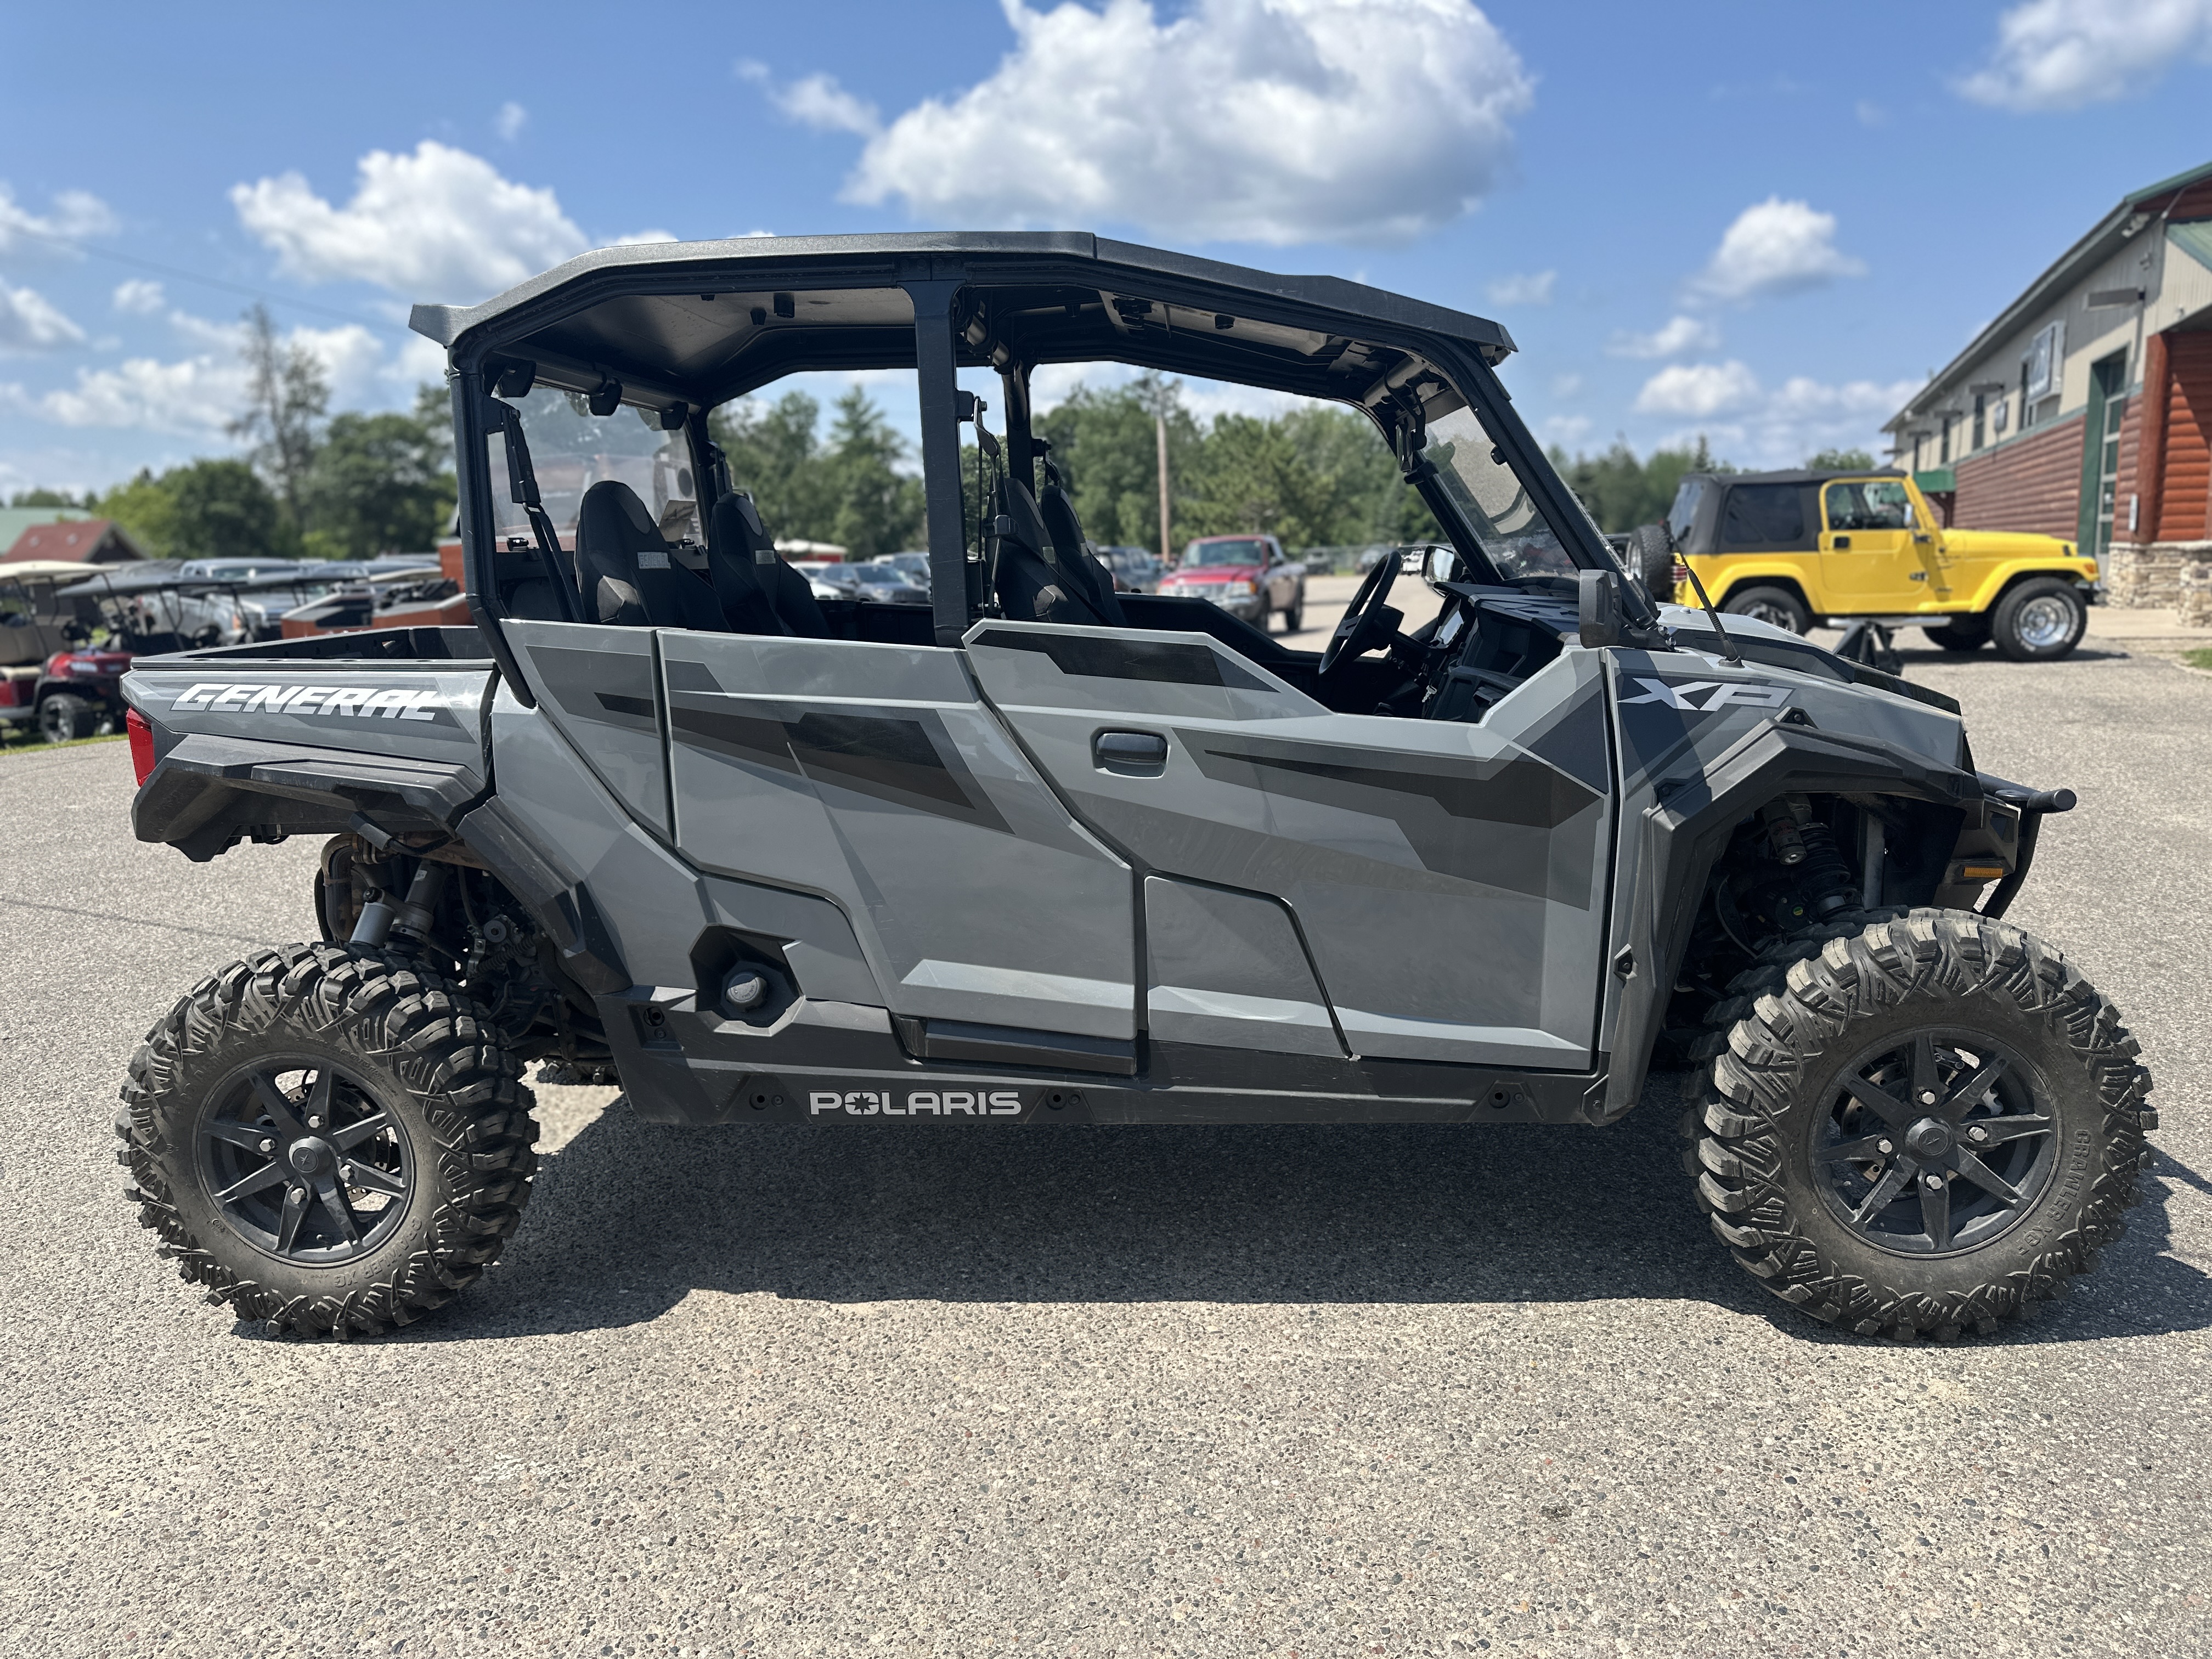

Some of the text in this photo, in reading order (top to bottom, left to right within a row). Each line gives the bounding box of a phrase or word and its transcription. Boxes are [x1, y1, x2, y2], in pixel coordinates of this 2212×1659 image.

[171, 683, 439, 721] GENERAL
[1617, 678, 1794, 712] XP
[809, 1092, 1022, 1115] POLARIS
[2046, 1128, 2091, 1222] CRAWLER
[360, 1215, 422, 1279] CRAWLER
